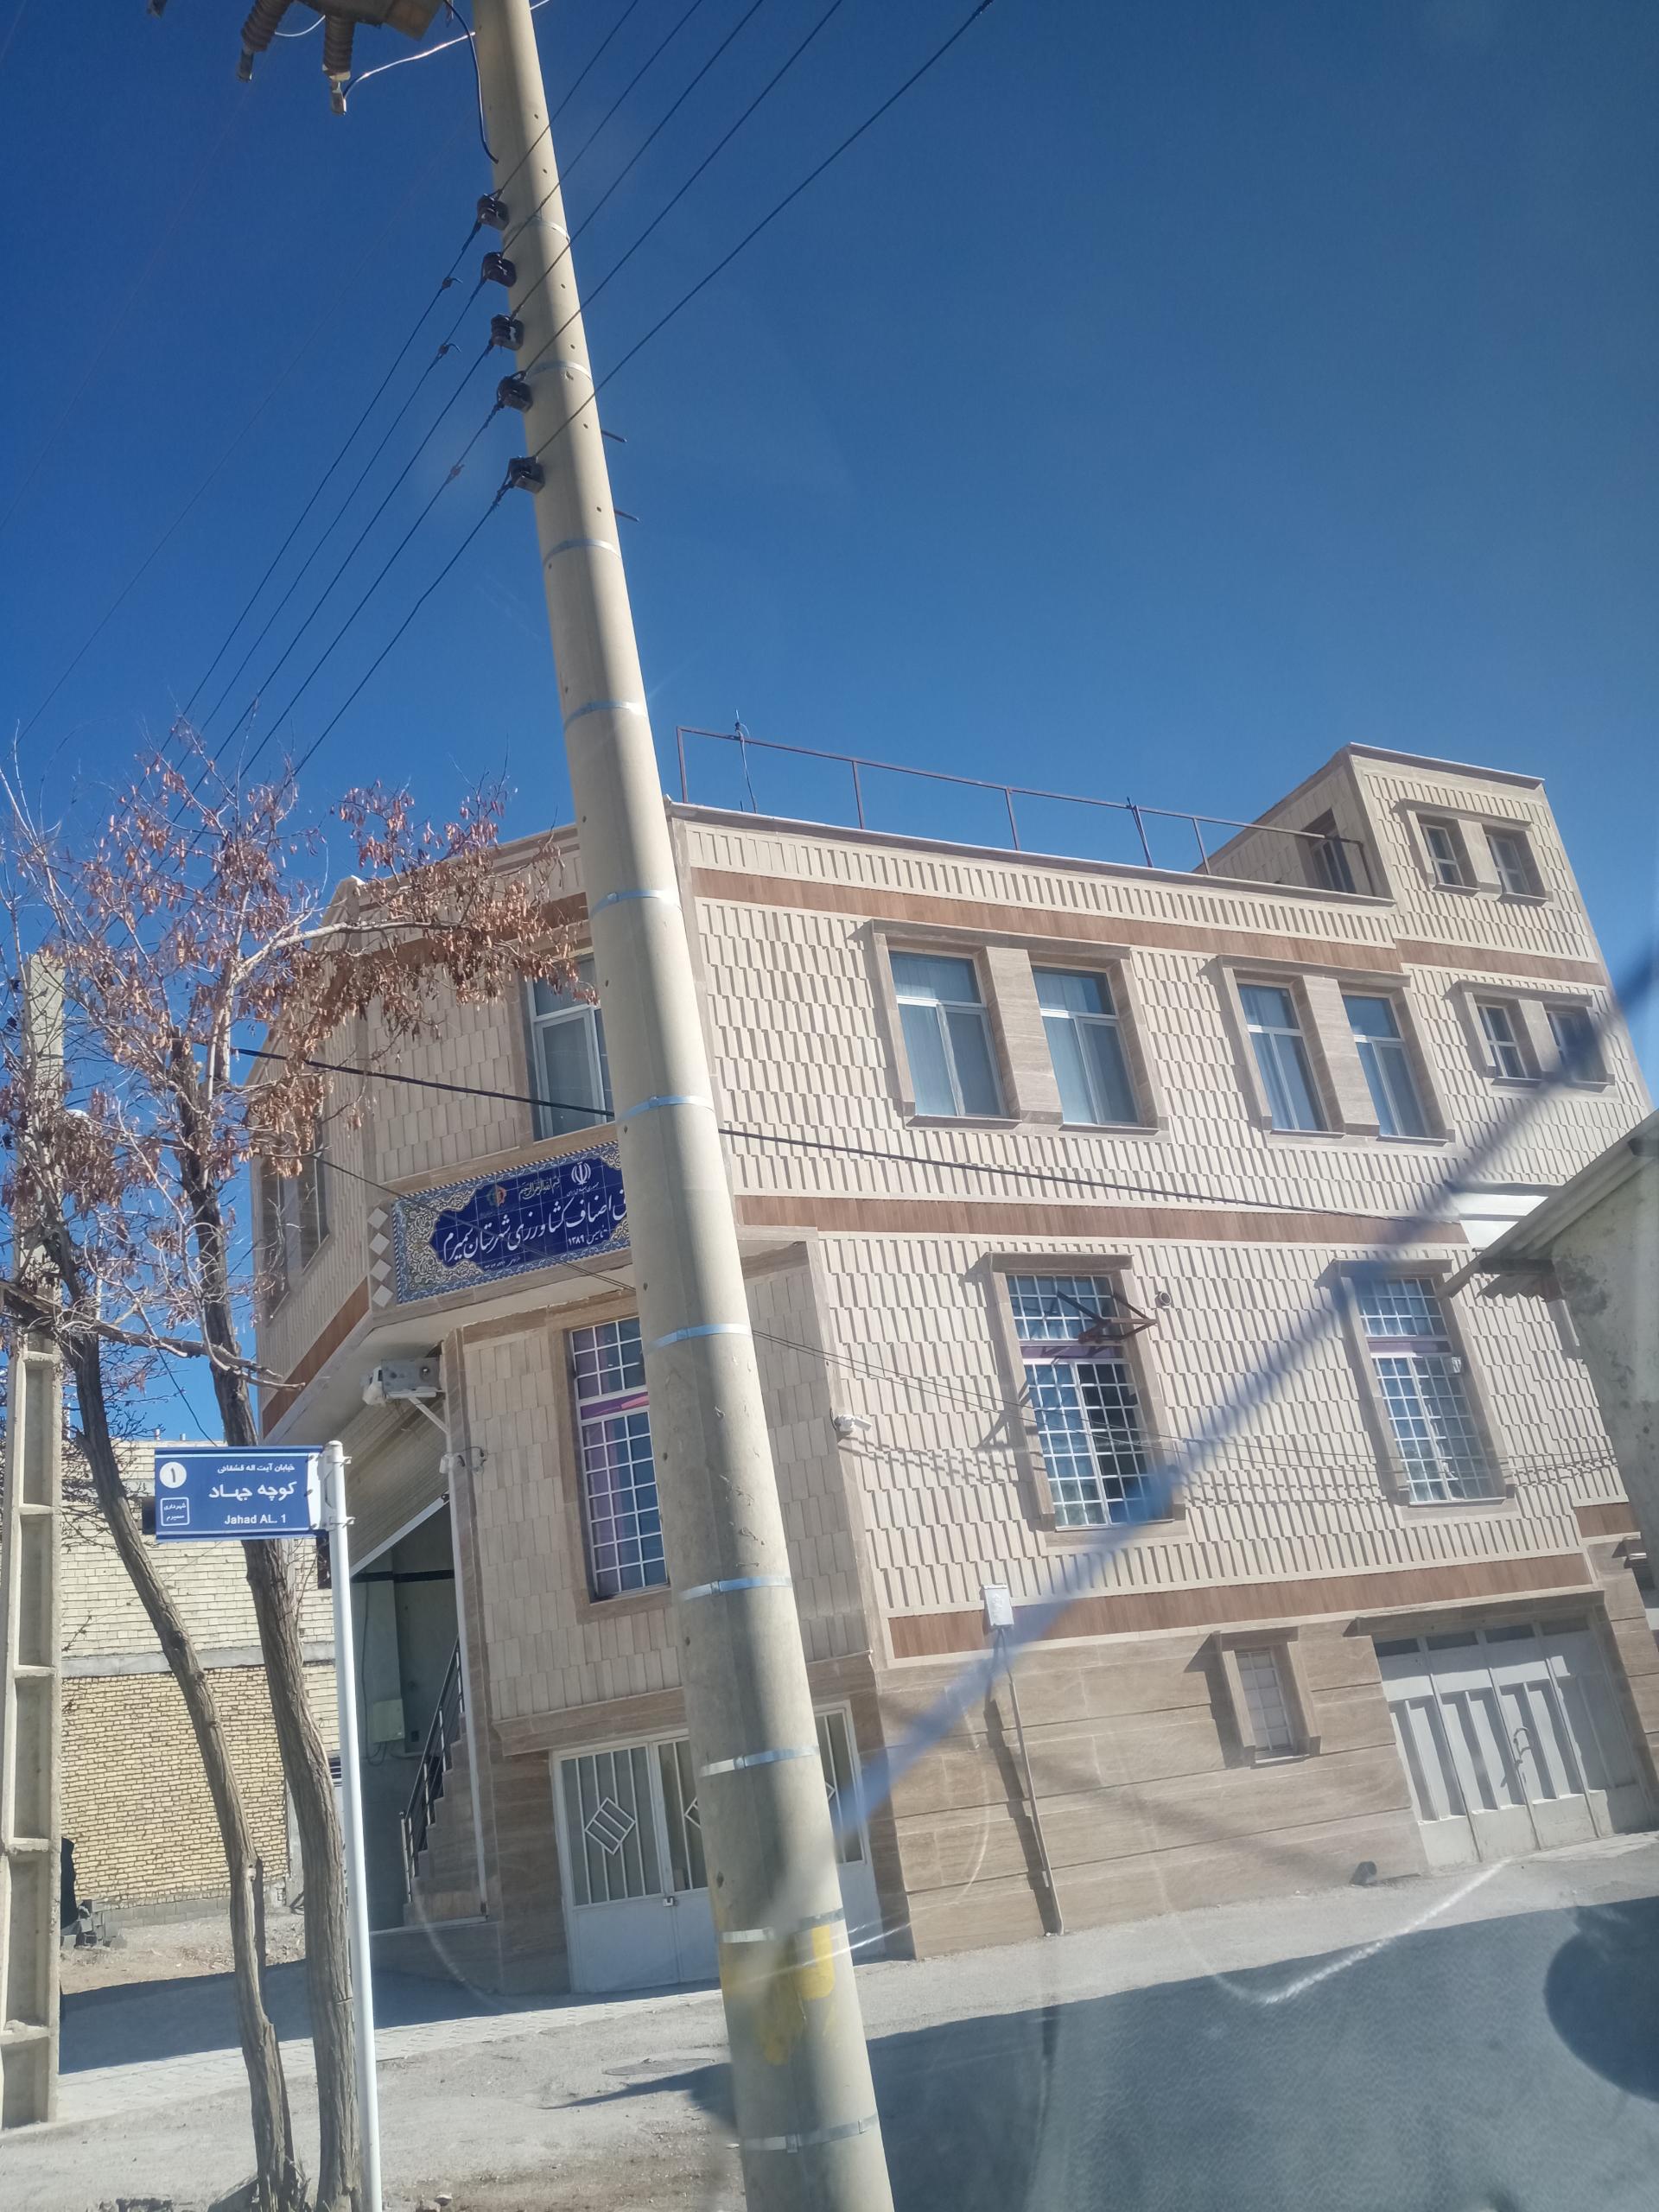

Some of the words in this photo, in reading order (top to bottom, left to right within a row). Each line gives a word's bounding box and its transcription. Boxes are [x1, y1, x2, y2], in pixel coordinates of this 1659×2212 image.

[566, 1194, 612, 1228] اصناف
[507, 1196, 574, 1251] کشاورزی
[443, 1226, 474, 1262] سمیرم
[463, 1214, 511, 1259] شهرستان
[568, 1234, 585, 1246] ۱۳۸۹
[171, 1467, 176, 1483] ۱
[257, 1463, 272, 1472] آیت
[274, 1463, 296, 1471] خیابان
[257, 1480, 297, 1502] کوچه
[224, 1515, 257, 1524] Jahad
[281, 1514, 286, 1523] 1
